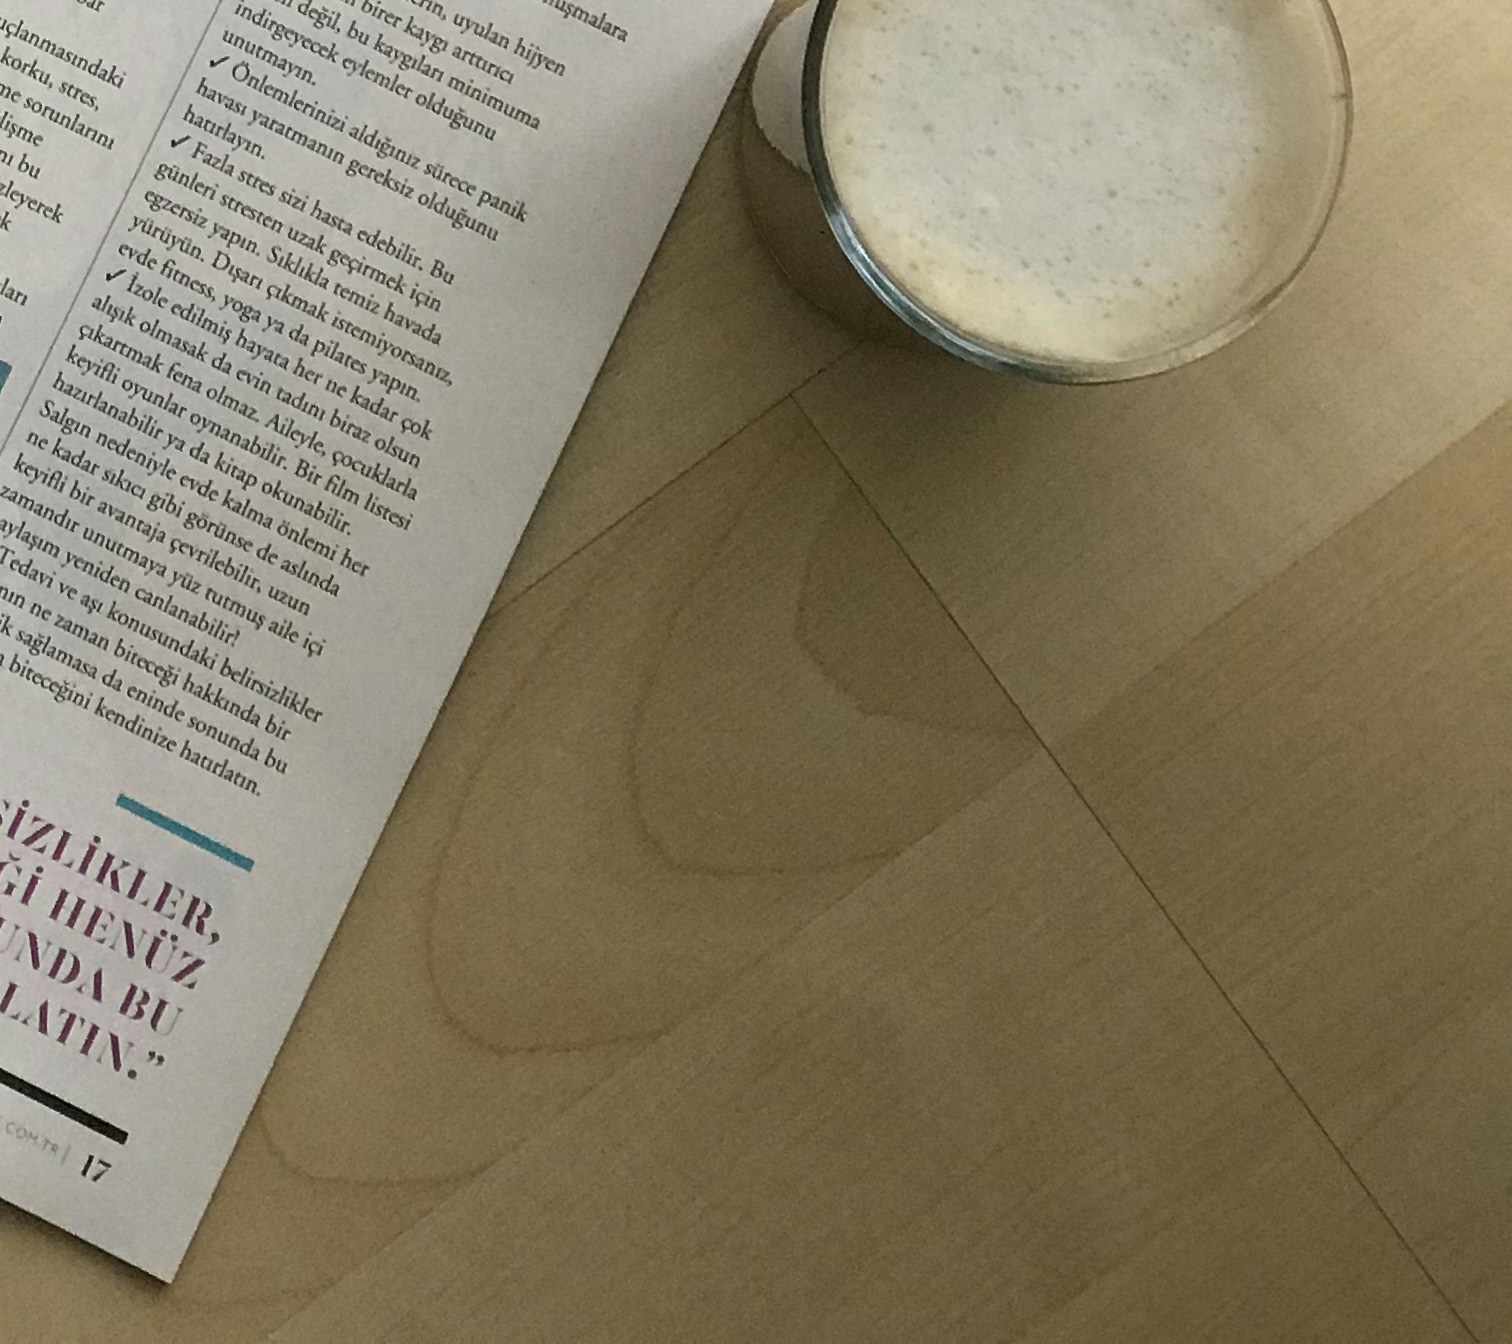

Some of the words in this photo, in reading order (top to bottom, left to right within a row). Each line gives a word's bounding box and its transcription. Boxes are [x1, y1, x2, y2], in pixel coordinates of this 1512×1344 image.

[190, 141, 235, 178] Fazla
[237, 170, 277, 197] stres
[278, 188, 310, 213] sizi
[309, 199, 354, 236] hasta
[356, 229, 423, 272] edebilir.
[429, 258, 456, 286] Bu
[231, 60, 349, 133] Önlemlerinizi
[348, 124, 422, 170] aldığınız
[423, 163, 477, 197] sürece
[476, 190, 528, 223] panik
[51, 370, 164, 440] hazırlanabilir
[162, 433, 186, 453] ya
[188, 441, 211, 465] da
[213, 451, 258, 491] kitap
[261, 479, 351, 536] okunabilir.
[8, 653, 94, 710] biteceğini
[93, 696, 178, 753] kendinize
[178, 739, 261, 797] hatırlatın.
[15, 630, 98, 680] sağlamasa
[101, 668, 123, 693] da
[126, 685, 186, 723] eninde
[186, 716, 261, 762] sonunda
[263, 747, 288, 775] bu
[48, 888, 206, 990] HENÜZ
[118, 982, 184, 1032] BU
[80, 1154, 113, 1183] 17
